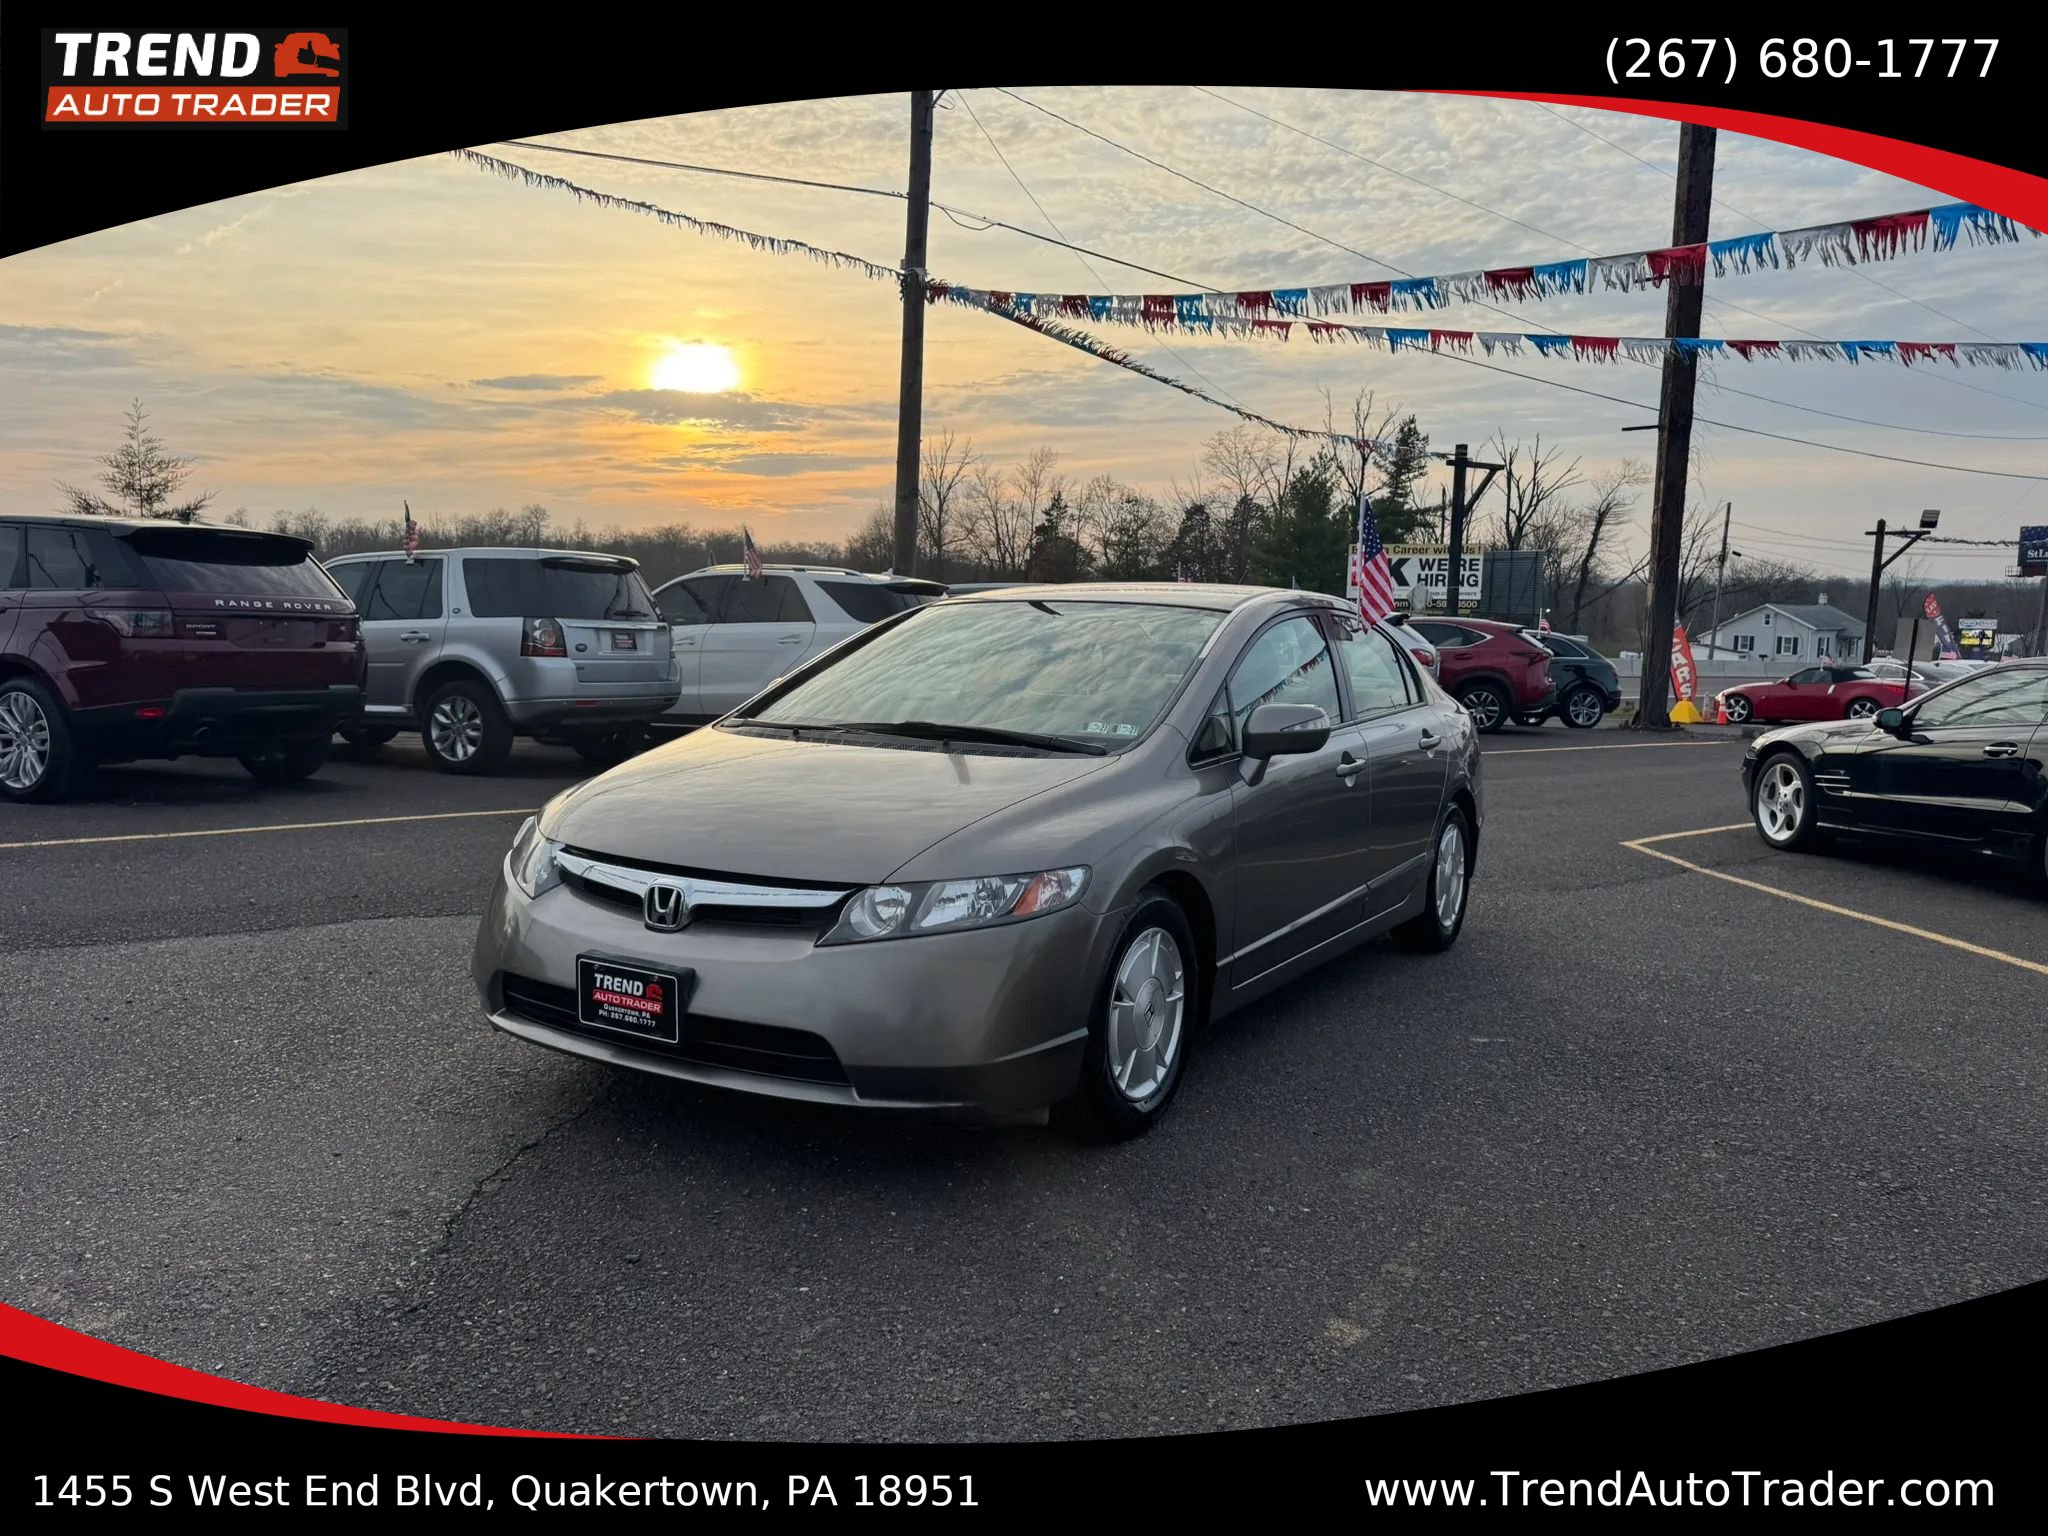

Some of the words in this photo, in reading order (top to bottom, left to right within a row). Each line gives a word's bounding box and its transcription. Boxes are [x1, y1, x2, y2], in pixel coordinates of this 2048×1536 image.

[1393, 545, 1430, 554] Career
[1433, 544, 1450, 554] wi
[1418, 558, 1480, 571] WERE
[1417, 573, 1479, 587] HIRNG
[215, 600, 274, 609] RANGE
[283, 602, 332, 611] ROVER
[594, 973, 644, 996] TREND
[594, 992, 620, 1003] AUTO
[620, 997, 661, 1012] TRADER
[598, 1009, 610, 1017] PH:
[641, 1011, 651, 1019] PA
